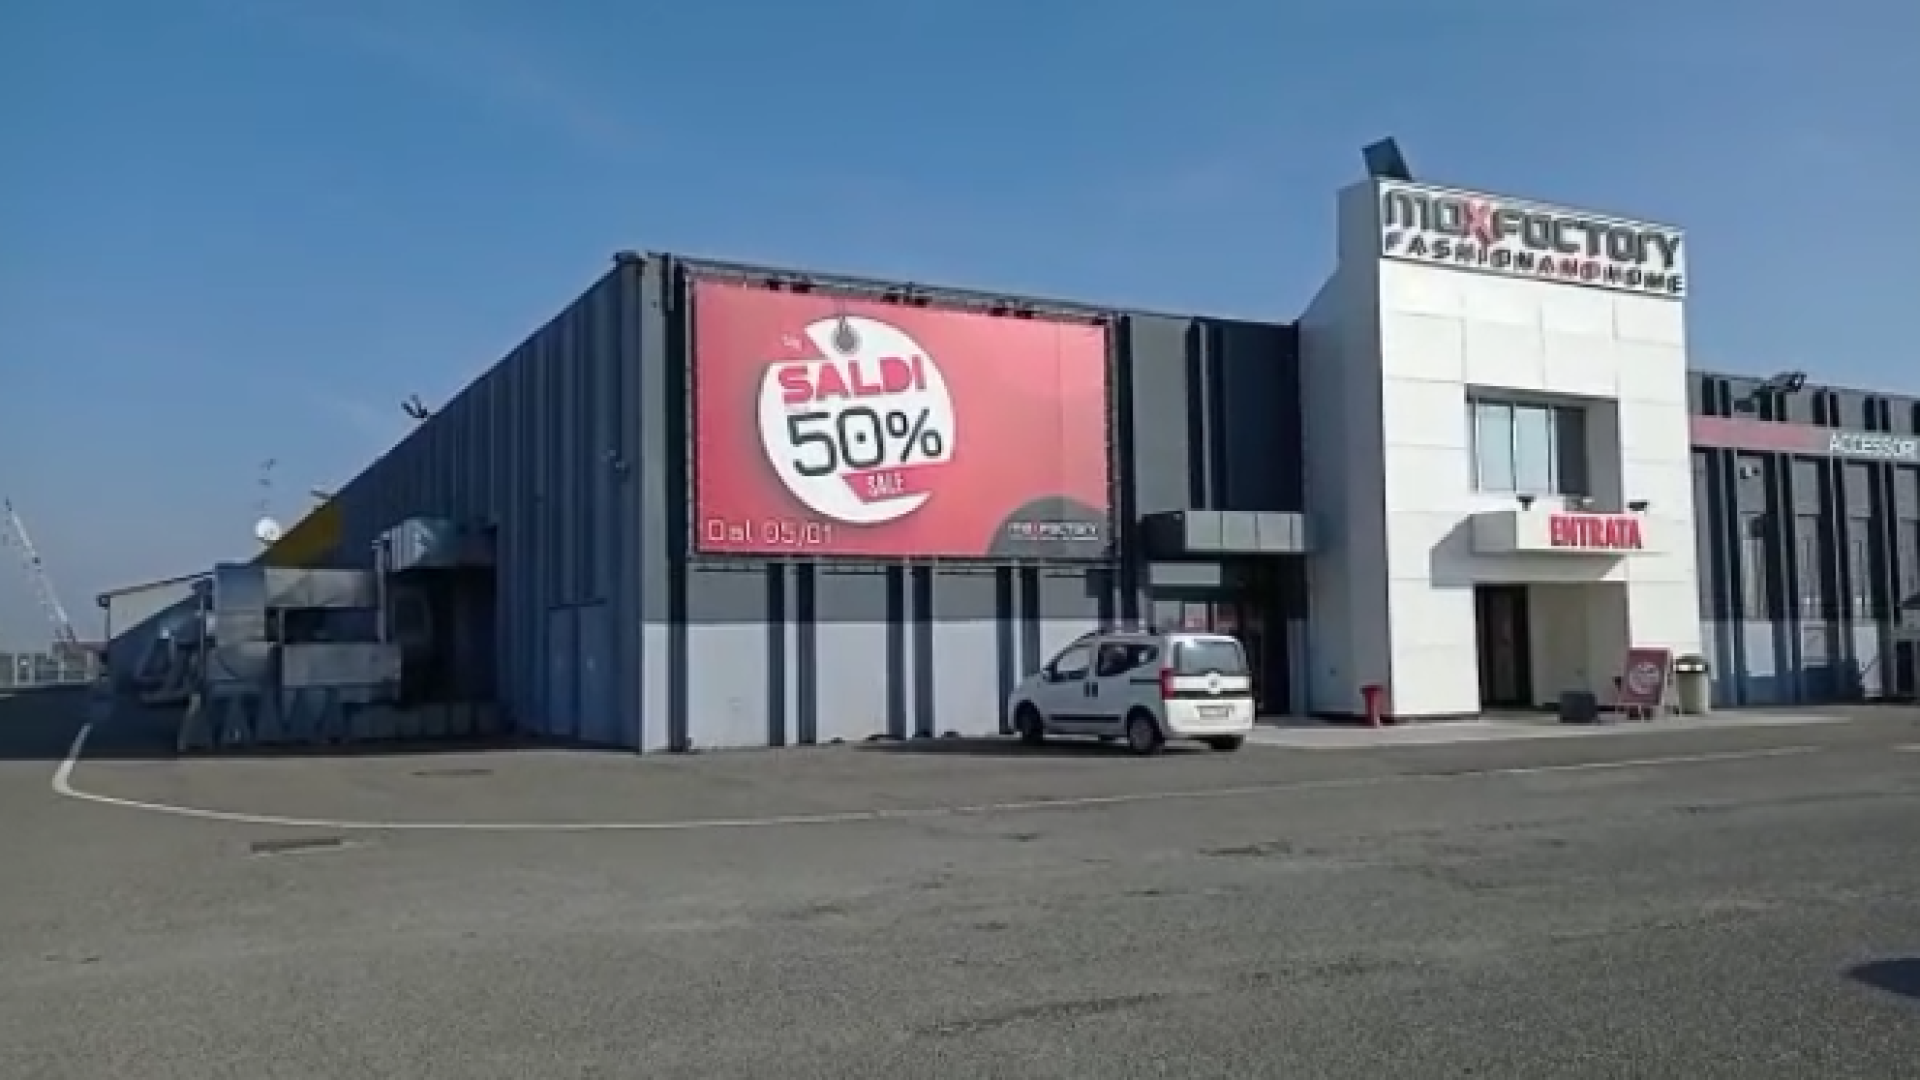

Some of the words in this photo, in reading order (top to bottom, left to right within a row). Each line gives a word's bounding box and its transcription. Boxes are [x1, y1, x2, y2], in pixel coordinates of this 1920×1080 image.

[778, 355, 926, 405] SALDI
[786, 407, 943, 477] 50%
[867, 473, 904, 497] SALE
[708, 519, 753, 543] Dal
[1549, 515, 1642, 549] ENTRATA
